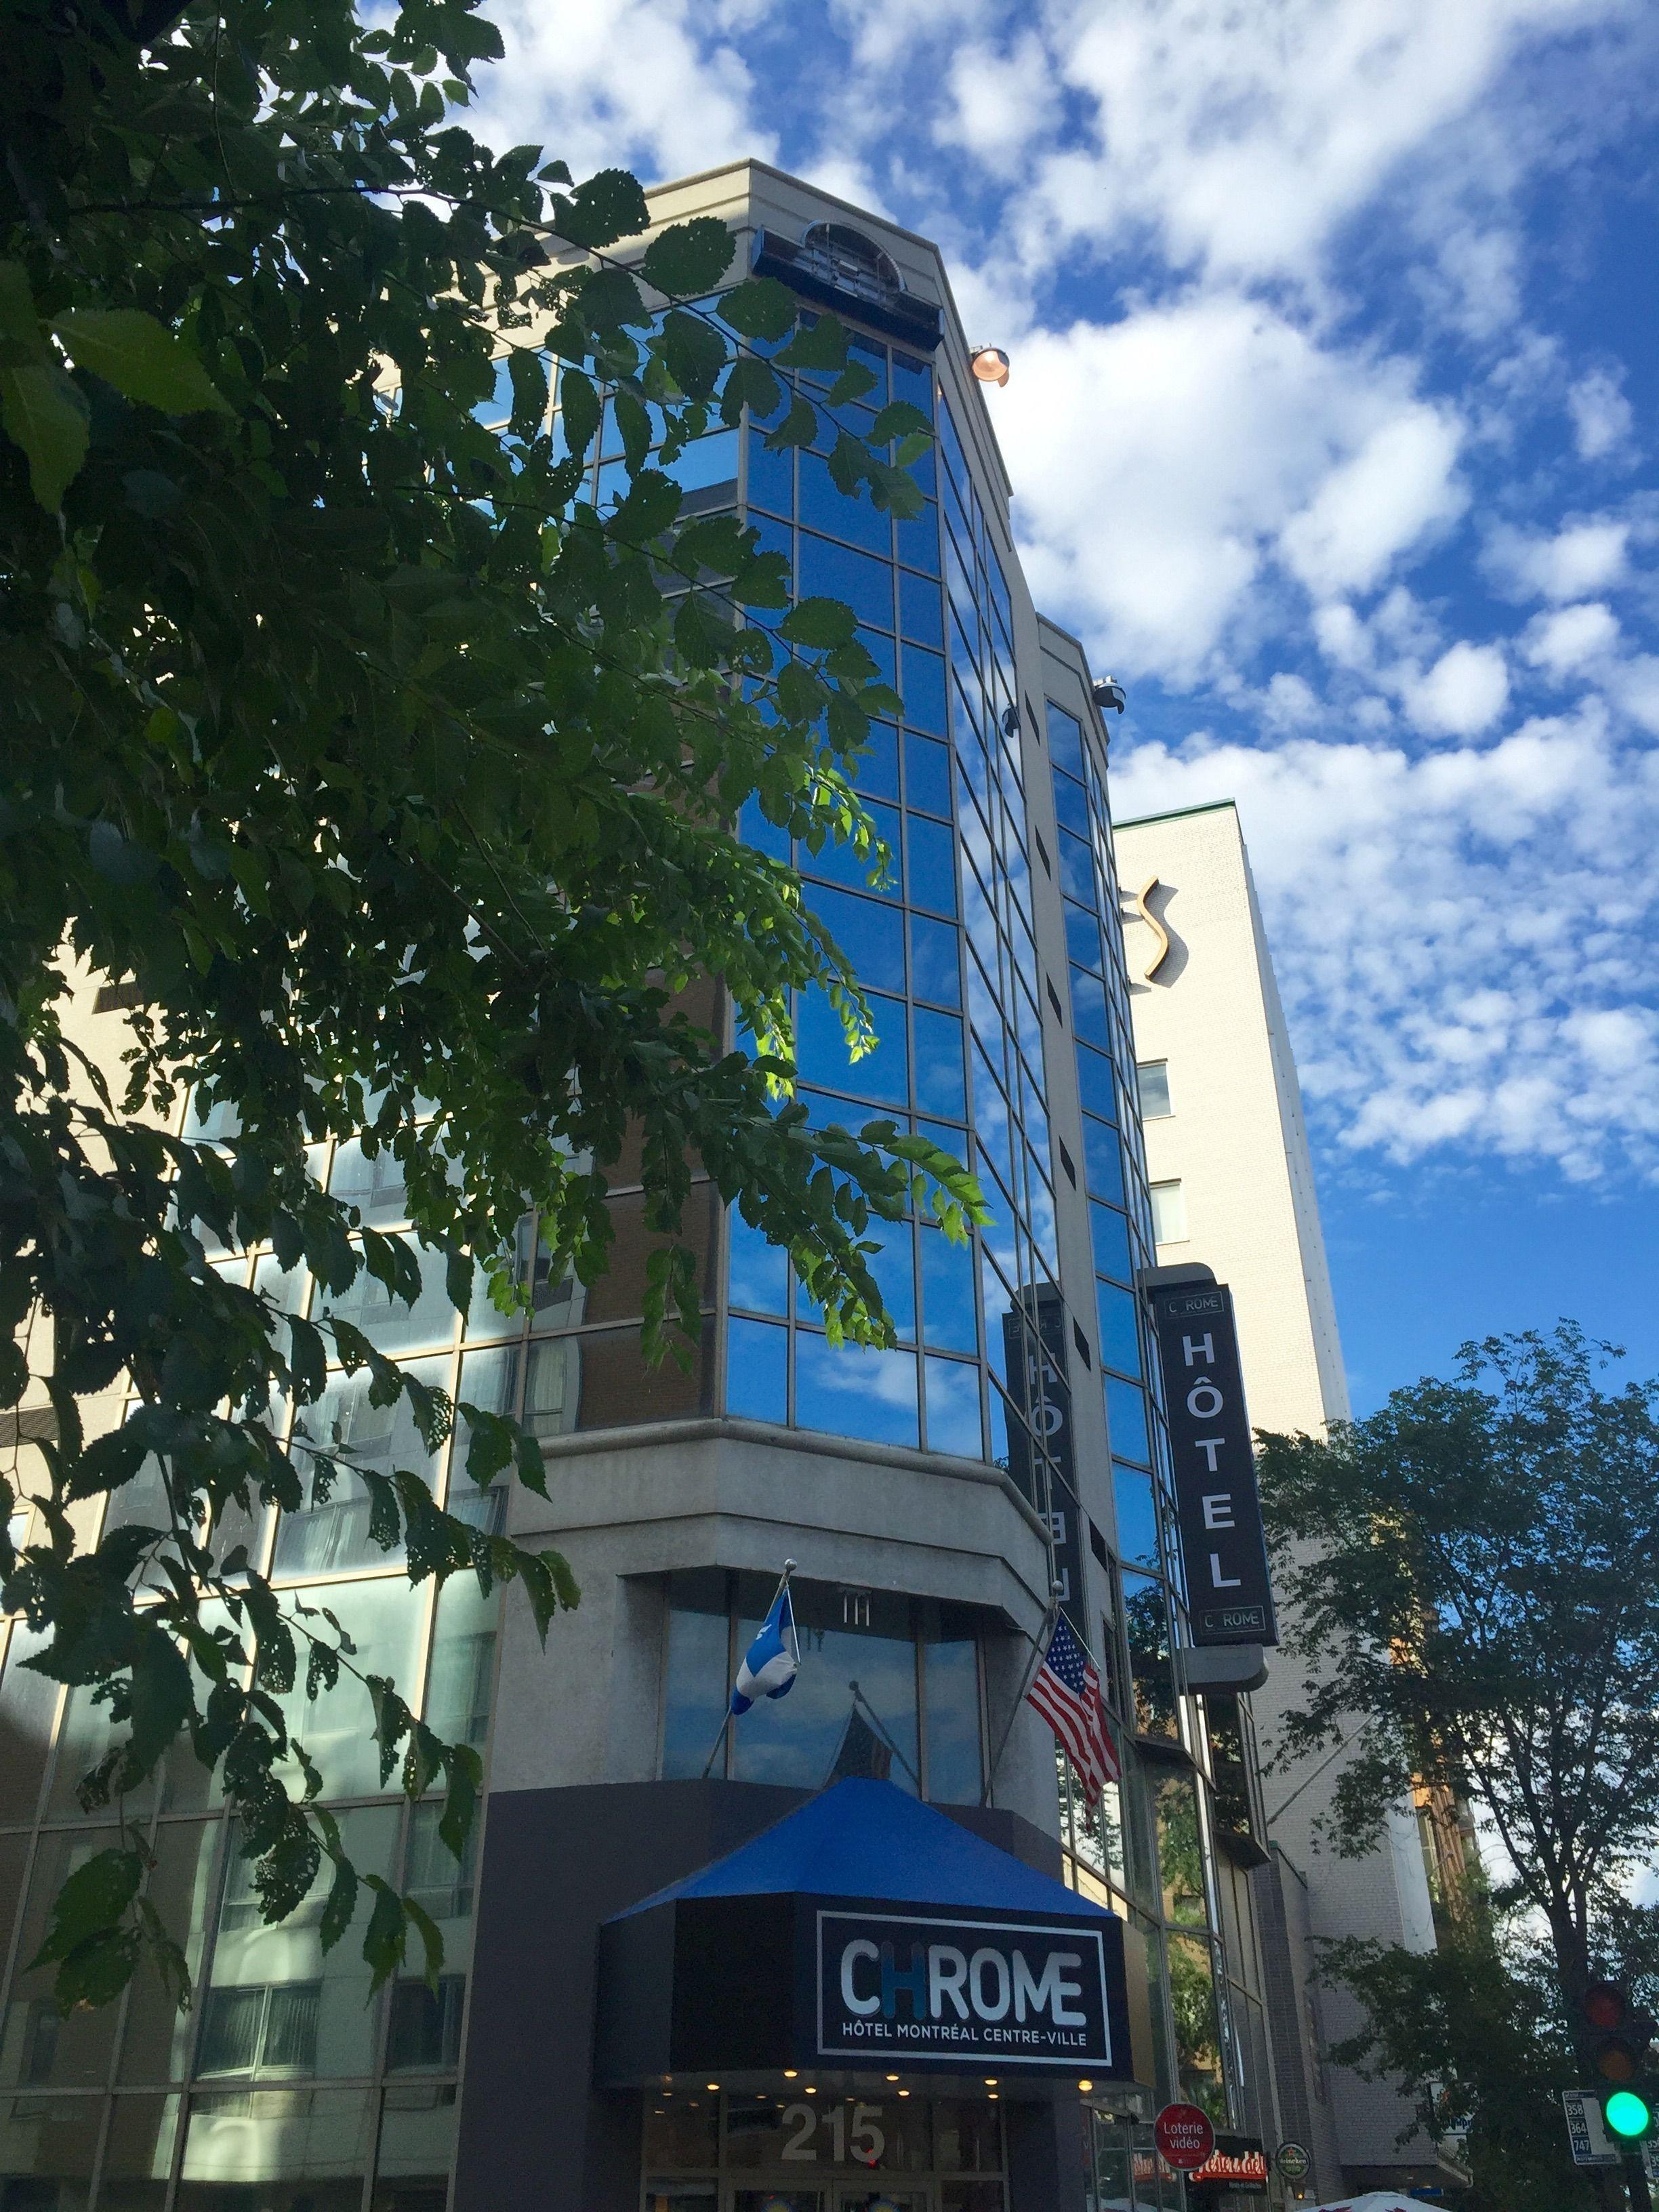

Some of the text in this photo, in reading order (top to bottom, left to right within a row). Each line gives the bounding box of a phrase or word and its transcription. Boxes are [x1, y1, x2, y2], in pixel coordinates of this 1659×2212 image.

[1169, 1296, 1218, 1313] CROME
[1182, 1332, 1242, 1589] HÔTEL
[1204, 1611, 1260, 1628] CROME
[840, 1939, 1087, 2027] CHROME
[842, 2020, 1087, 2047] HÔTEL MONTRÉAL CENTRE-VILLE
[1567, 2104, 1584, 2116] 358
[780, 2103, 885, 2165] 215
[1164, 2122, 1204, 2135] Loterie
[1570, 2122, 1587, 2134] 364
[1170, 2136, 1200, 2149] vidéo
[1574, 2140, 1589, 2151] 747
